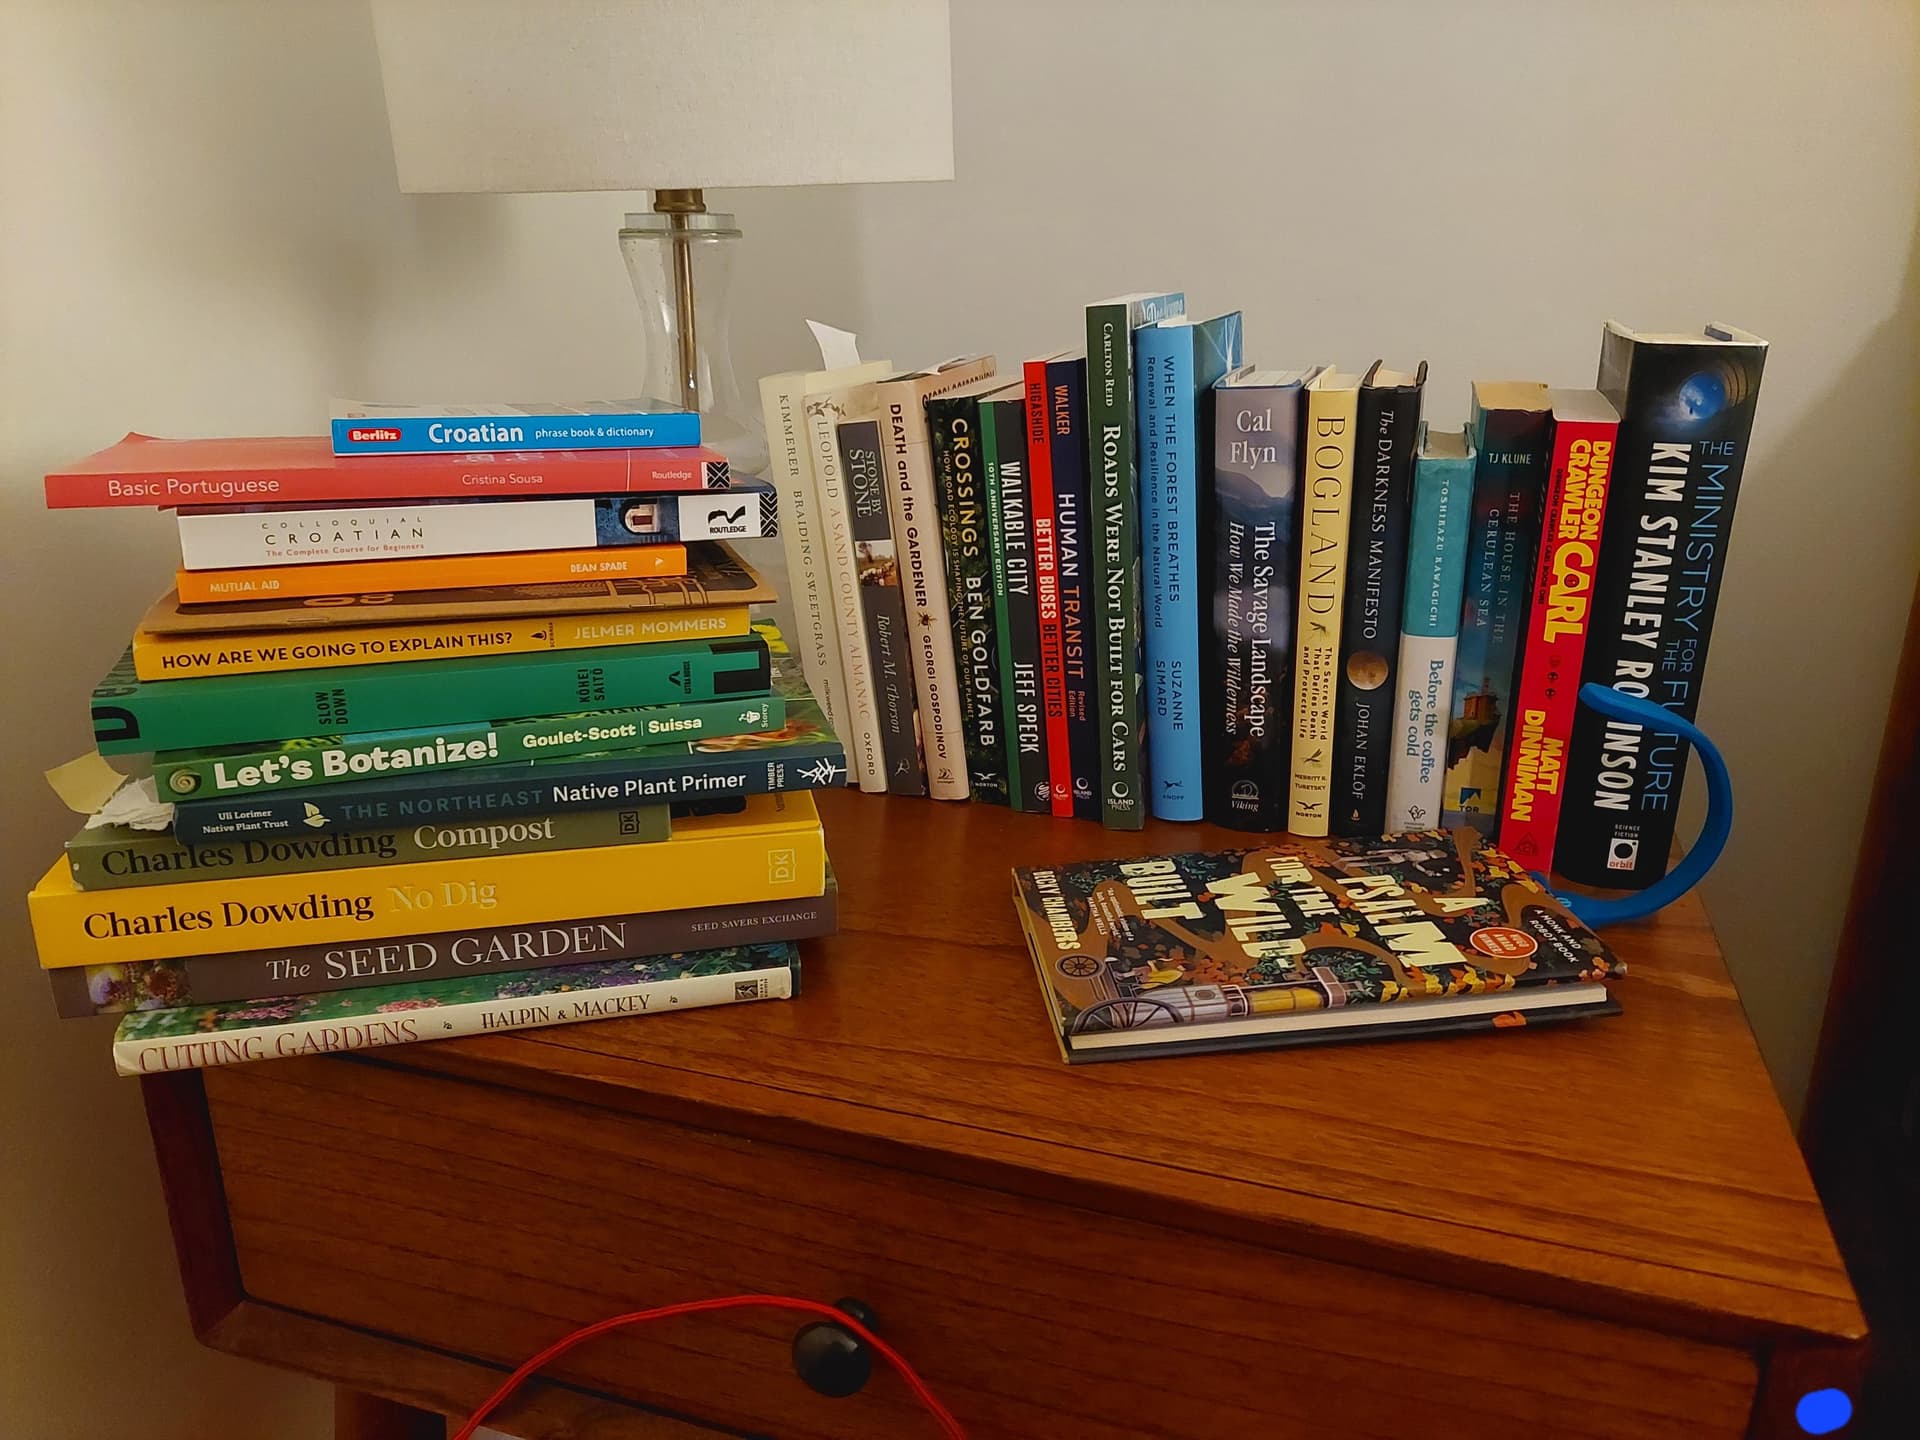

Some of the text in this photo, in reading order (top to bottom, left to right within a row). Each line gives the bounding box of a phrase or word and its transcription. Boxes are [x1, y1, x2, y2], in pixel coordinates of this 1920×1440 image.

[352, 430, 398, 441] Berlitz
[428, 422, 654, 444] Croatian phrase book & dictionary
[1230, 440, 1277, 470] Flyn
[1236, 408, 1272, 433] Cal
[1700, 441, 1735, 455] THE
[108, 470, 692, 498] Basic Portuguese Cristina Sousa Routledge
[849, 449, 873, 518] STONE
[1163, 355, 1180, 602] WHEN THE FOREST BREATHES
[1488, 453, 1531, 464] TJ KLUNE
[1558, 439, 1592, 539] CRAWLER
[1579, 440, 1612, 541] DUNGEON
[265, 528, 423, 545] CROATIAN
[709, 525, 747, 534] ROUTLEDGE
[779, 394, 828, 666] KIMMERER BRAIDING SWEETGRASS
[890, 404, 927, 607] DEATH and the GARDENER
[1054, 385, 1085, 679] WALKER HUMAN TRANSIT
[1307, 415, 1346, 614] BOGLAND
[1363, 410, 1395, 639] The DARKNESS MANIFESTO
[209, 561, 628, 593] MUTUAL AID DEAN SPADE
[952, 418, 995, 746] CROSSINGS BEN GOLDFARB
[1029, 382, 1062, 718] HIGASHIDE BETTER BUSES BETTER CITIES
[1103, 323, 1130, 772] CARLTON REID ROADS WERE NOT BUILT FOR CARS
[1429, 479, 1450, 627] TOSHIKAZU KAWAGUCHI
[1477, 508, 1500, 626] CERULEAN SEA
[1674, 464, 1729, 631] MINISTRY
[1000, 461, 1039, 753] WALKABLE CITY JEFF SPECK
[1544, 541, 1594, 643] CARL
[1594, 442, 1692, 811] KIM STANLEY ROINSON
[162, 632, 513, 669] HOW ARE WE GOING TO EXPLAIN THIS?
[574, 618, 727, 639] JELMER MOMMERS
[1226, 521, 1245, 736] How We Made the Wilderness
[1244, 521, 1276, 737] The Savage Landscape
[1662, 639, 1680, 671] THE
[1678, 638, 1697, 672] FOR
[315, 691, 332, 725] SLOW
[332, 688, 348, 725] DOWN
[877, 614, 900, 733] Robert M. Thorson
[922, 635, 947, 759] GEORGI GOSPODINOV
[1156, 660, 1167, 716] SIMARD
[1171, 660, 1183, 731] SUZANNE
[761, 703, 769, 728] Storey
[1407, 689, 1423, 757] gets cold
[1419, 660, 1444, 784] Before the coffee
[213, 717, 702, 790] Let’s Botanize! Goulet-Scott Suissa
[863, 731, 876, 775] OXFORD
[1351, 702, 1371, 800] JOHAN EKLÖF
[1511, 710, 1545, 822] DINNIMAN
[1537, 737, 1564, 794] MATT
[203, 820, 289, 834] Native Plant Trust
[218, 808, 272, 821] Uli Lorimer
[340, 774, 746, 819] THE NORTHEAST Native Plant Primer
[101, 816, 555, 876] Charles Dowding Compost
[84, 880, 497, 940] Charles Dowding No Dig
[1032, 870, 1082, 950] BECKY CHAMBERS
[1118, 860, 1207, 920] BUILT
[1265, 856, 1340, 918] FOR THE
[1336, 873, 1466, 968] PSALM
[1433, 897, 1489, 913] A
[266, 911, 818, 981] The SEED GARDEN SEED SAVERS EXCHANGE
[138, 994, 651, 1072] CUTTING GARDENS HALPIN & MACKEY
